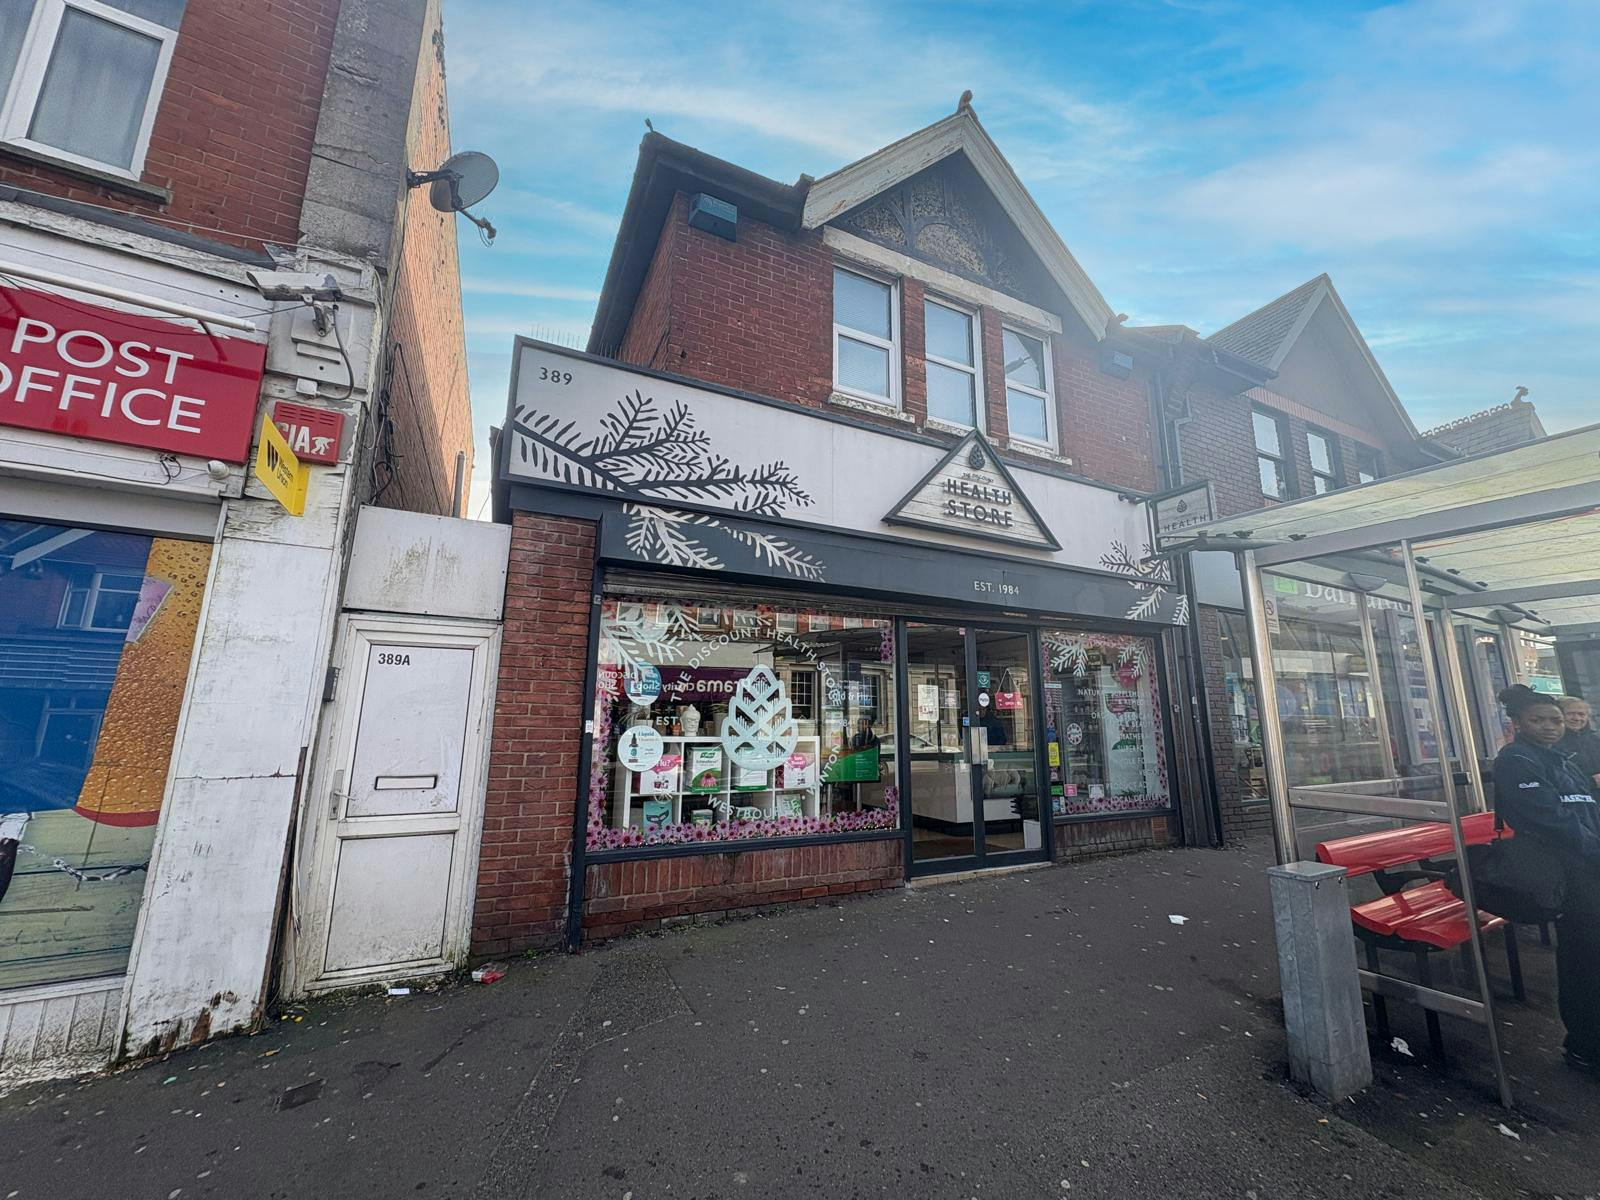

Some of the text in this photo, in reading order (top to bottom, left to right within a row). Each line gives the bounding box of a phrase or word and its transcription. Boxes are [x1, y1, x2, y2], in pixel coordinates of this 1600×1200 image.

[11, 316, 194, 385] POST
[539, 366, 573, 386] 389
[0, 361, 206, 434] FFICE
[946, 478, 1012, 504] HEALTH
[948, 500, 1014, 527] STORE
[1163, 513, 1206, 532] HEALTH
[974, 581, 1020, 596] EST. 1984
[378, 652, 411, 666] 389A
[670, 670, 692, 703] THE
[688, 627, 761, 670] DISCOUNT
[766, 627, 818, 662] HEALTH
[656, 716, 681, 726] EST.
